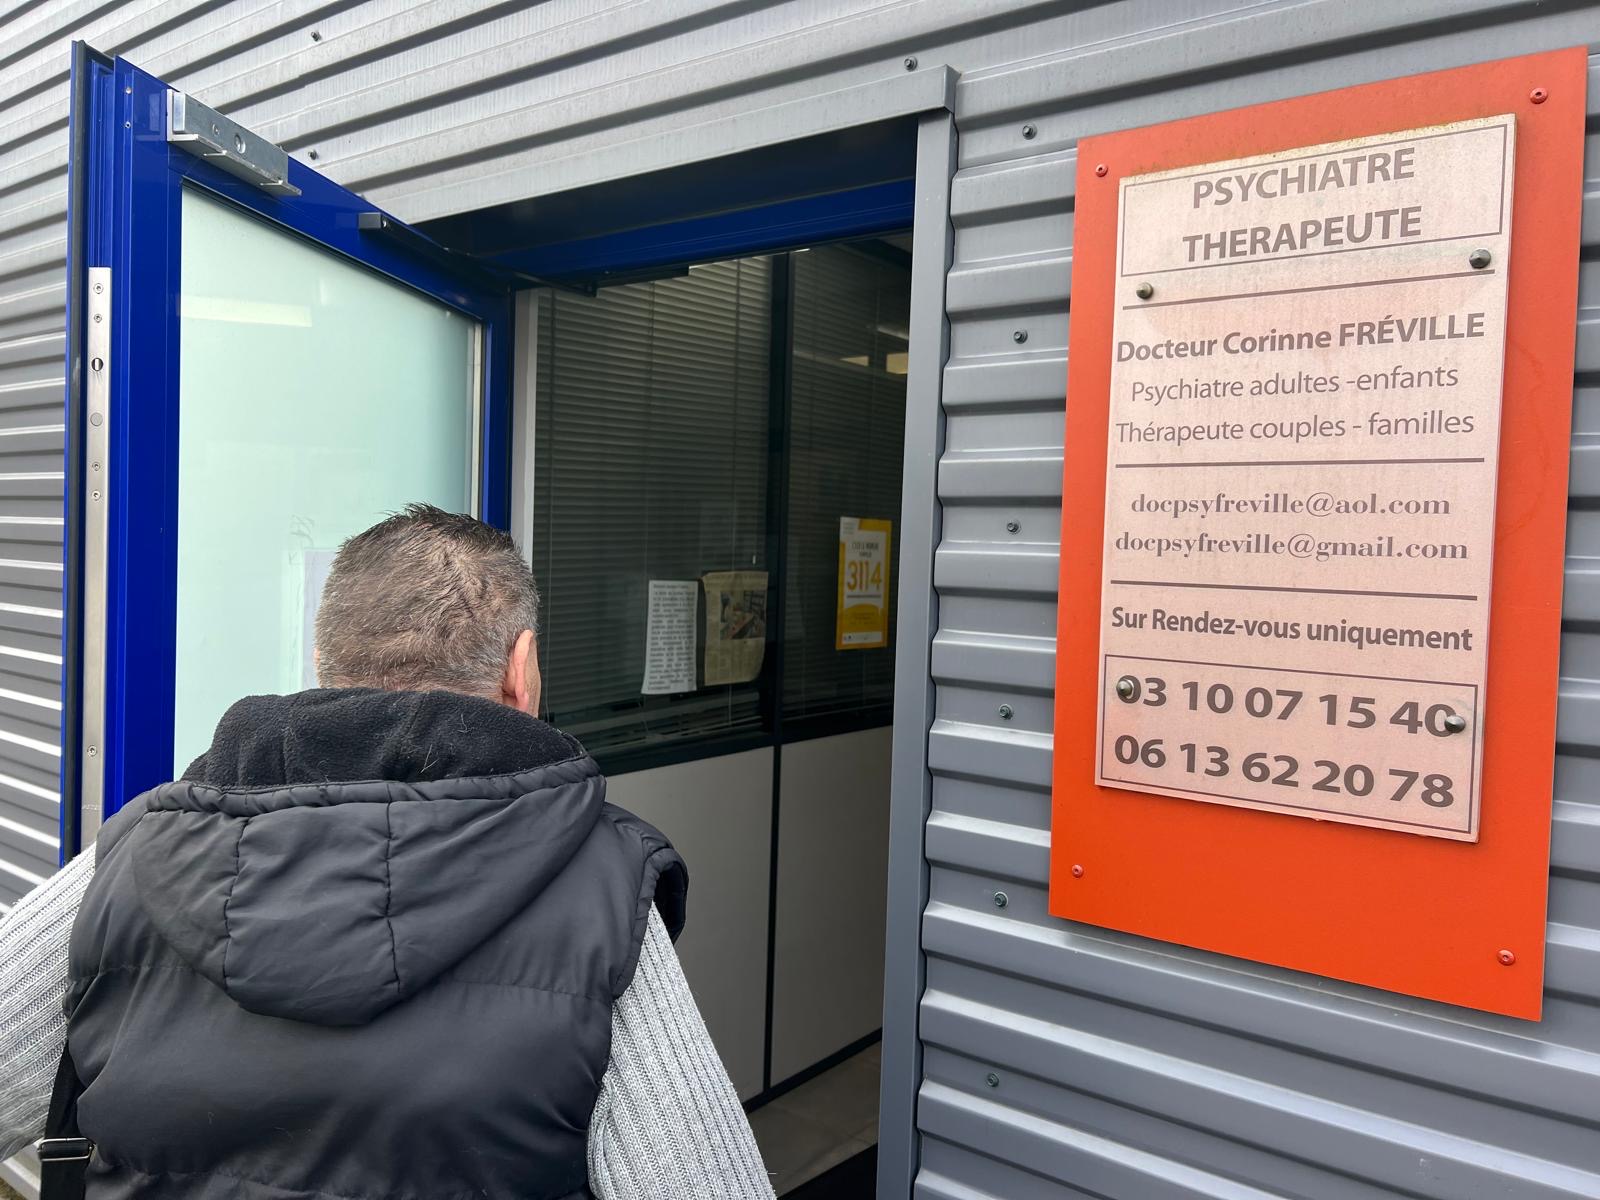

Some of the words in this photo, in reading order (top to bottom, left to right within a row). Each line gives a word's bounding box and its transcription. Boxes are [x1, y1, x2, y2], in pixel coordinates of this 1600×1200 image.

[1192, 147, 1416, 209] PSYCHIATRE
[1182, 205, 1423, 263] THERAPEUTE
[1116, 337, 1218, 362] Docteur
[1222, 328, 1332, 355] Corinne
[1338, 312, 1486, 347] FRÉVILLE
[1131, 376, 1244, 407] Psychiatre
[1249, 371, 1340, 397] adultes
[1115, 421, 1244, 447] Thérapeute
[1249, 414, 1346, 443] couples
[1367, 409, 1475, 436] familles
[1130, 491, 1451, 519] docpsyfreville@aol.com
[1115, 531, 1469, 562] docpsyfreville@gmail.com
[847, 560, 882, 592] 3114
[1111, 605, 1148, 629] Sur
[1151, 607, 1301, 639] Rendez-vous
[1307, 618, 1474, 652] uniquement
[1118, 674, 1168, 706] 03
[1181, 681, 1234, 714] 10
[1244, 686, 1304, 721] 07
[1319, 693, 1377, 729] 15
[1389, 700, 1457, 738] 40
[1114, 734, 1167, 768] 06
[1179, 742, 1231, 777] 13
[1241, 752, 1300, 788] 62
[1312, 759, 1375, 797] 20
[1387, 768, 1455, 808] 78
